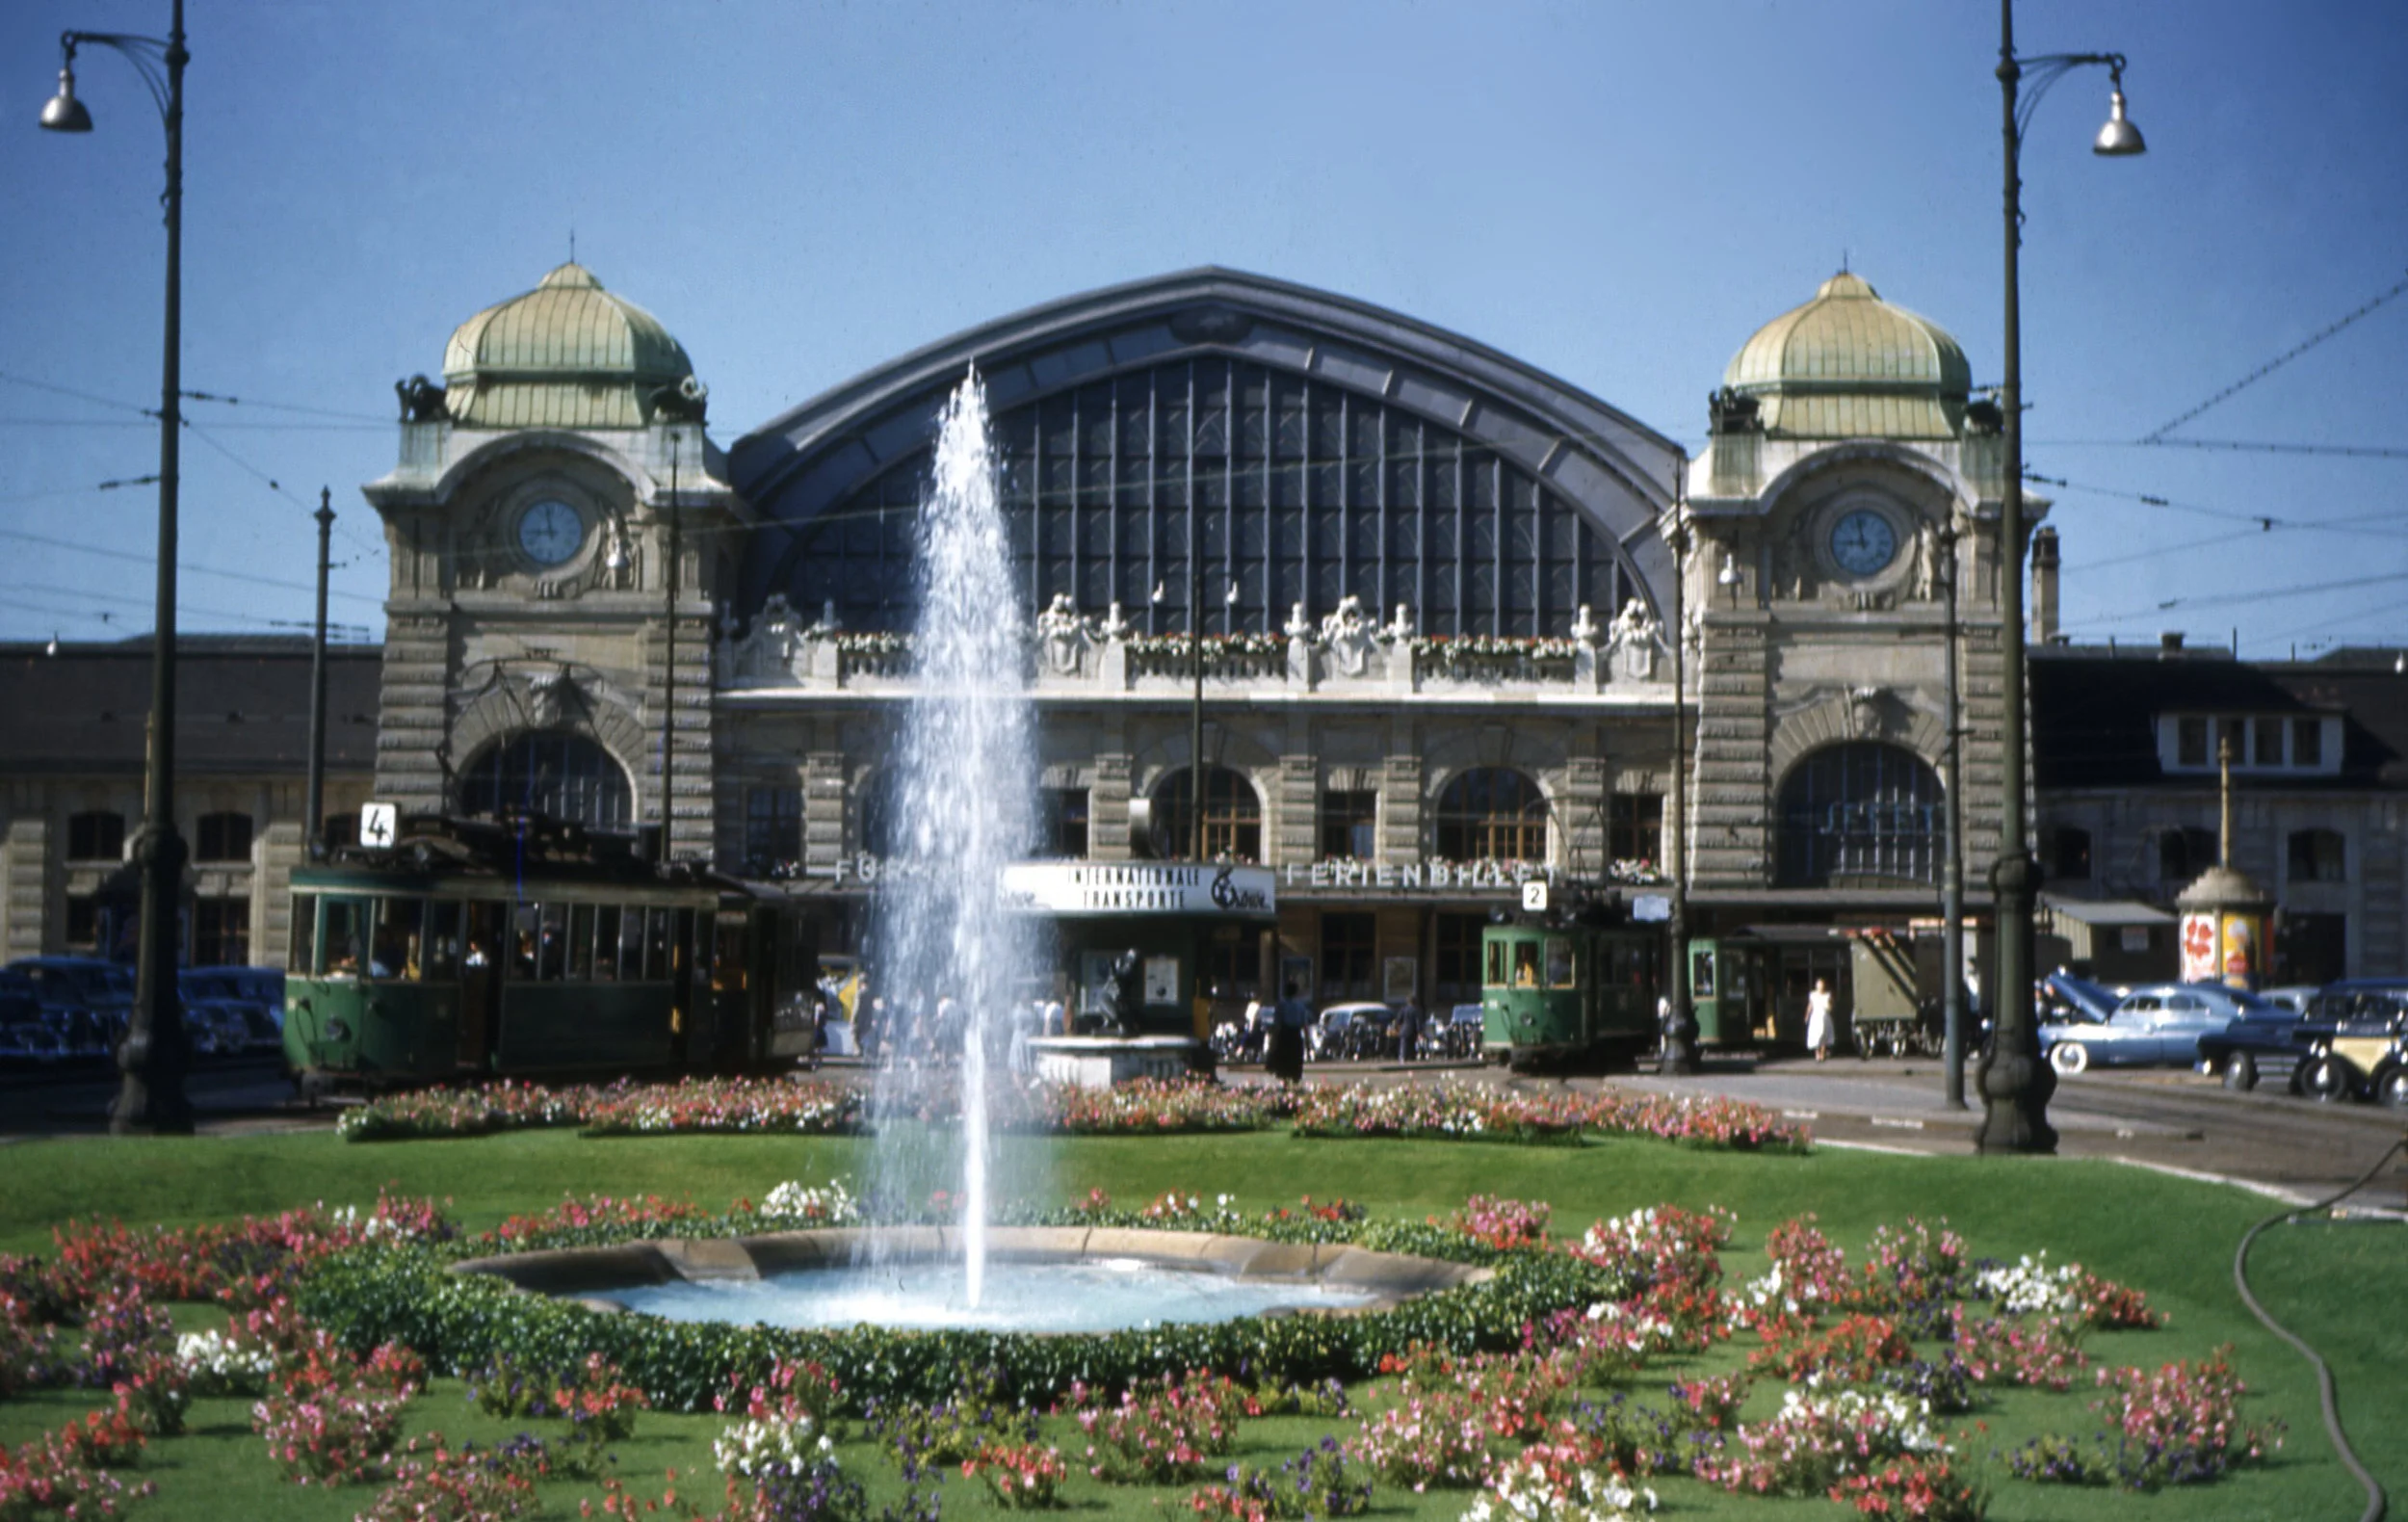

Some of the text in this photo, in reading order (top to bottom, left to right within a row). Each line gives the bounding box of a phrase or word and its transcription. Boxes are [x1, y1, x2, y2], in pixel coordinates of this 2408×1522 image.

[368, 808, 388, 843] 4
[1067, 866, 1200, 887] INTERNATIONALE
[1084, 889, 1186, 910] TRANSPORTE
[1530, 886, 1540, 905] 2
